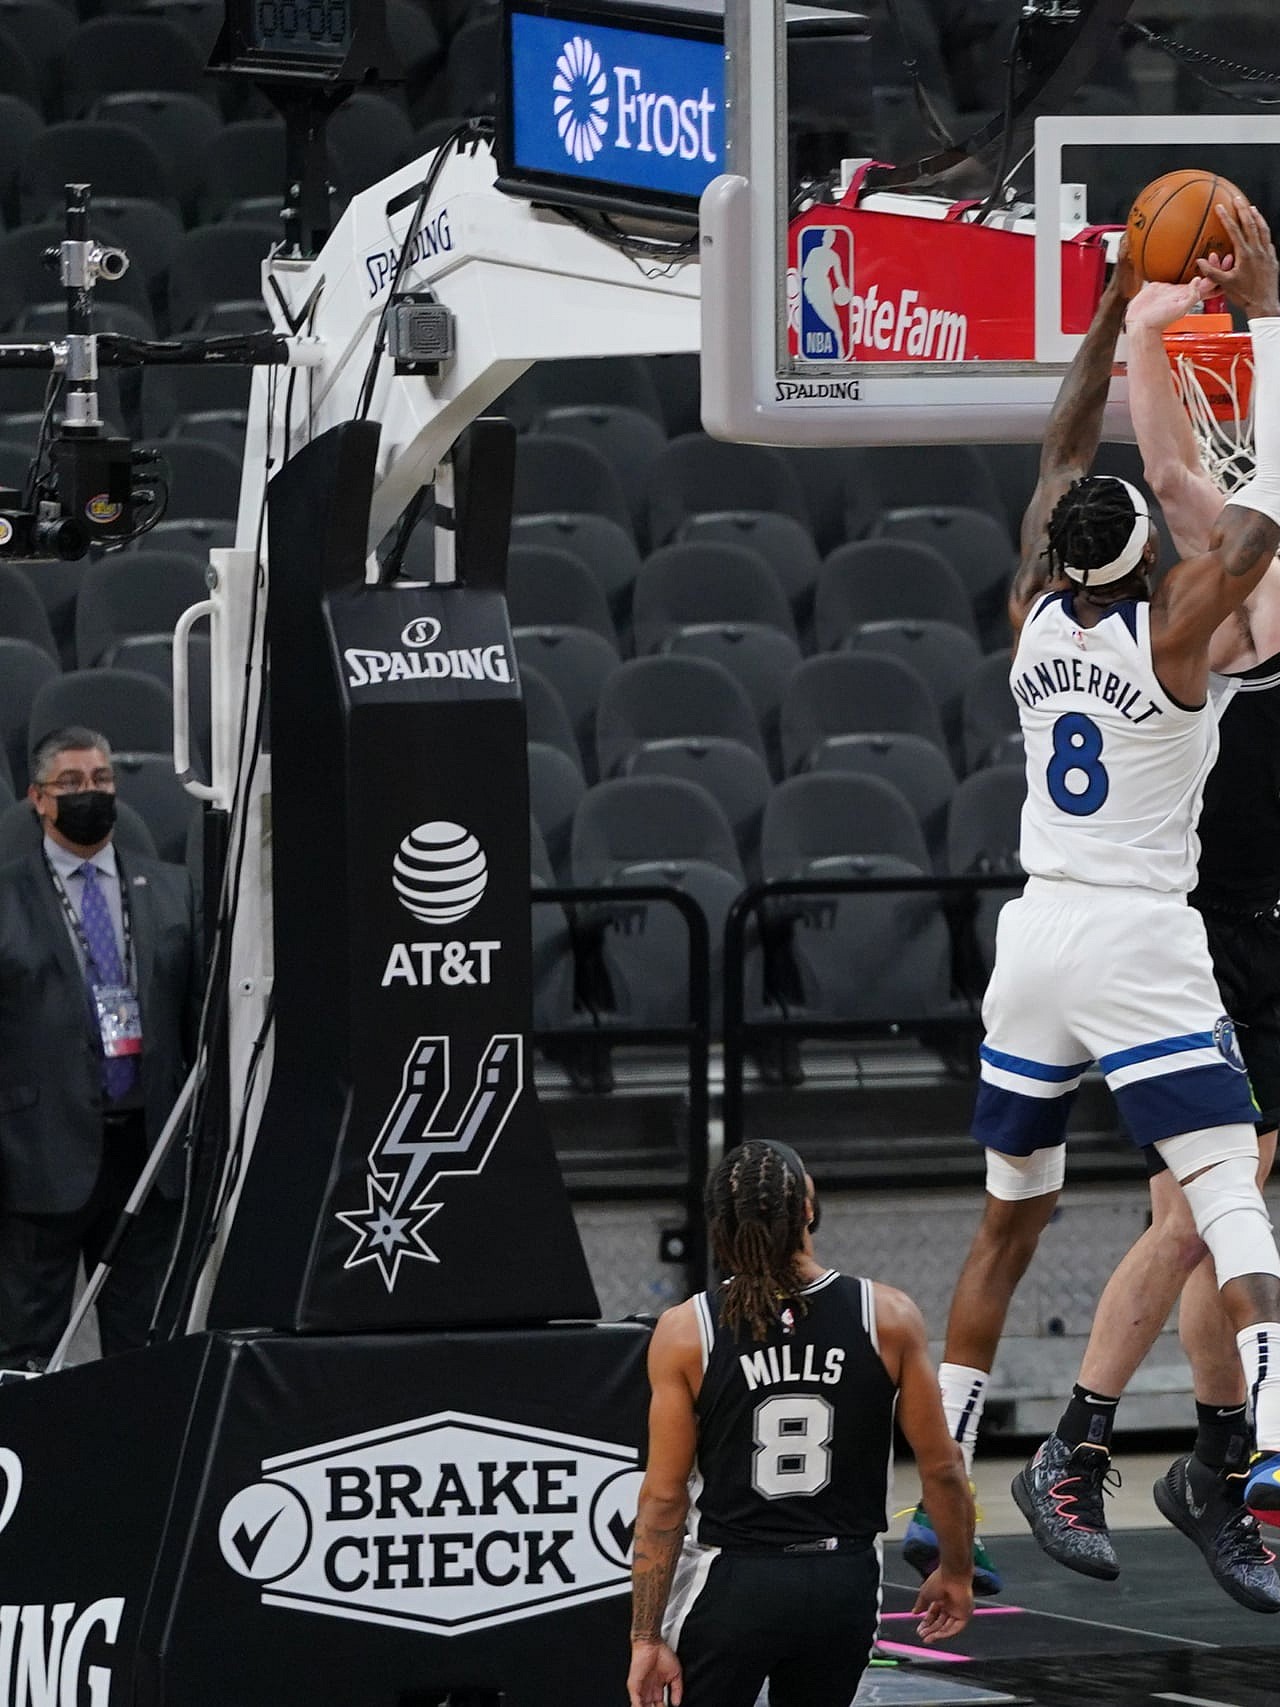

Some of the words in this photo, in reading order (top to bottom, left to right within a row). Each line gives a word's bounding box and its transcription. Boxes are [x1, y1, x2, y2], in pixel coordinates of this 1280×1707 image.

[613, 66, 717, 163] Frost
[366, 208, 454, 300] SPADING
[806, 332, 834, 354] NBA
[775, 381, 860, 402] SPALDING
[344, 645, 510, 687] SPALDING
[1013, 658, 1163, 725] VANDERBILT
[1046, 711, 1109, 816] 8
[380, 940, 501, 987] AT&T
[739, 1344, 846, 1391] MILLS
[751, 1393, 835, 1501] 8
[325, 1460, 578, 1522] BRAKE
[324, 1529, 576, 1593] CHECK
